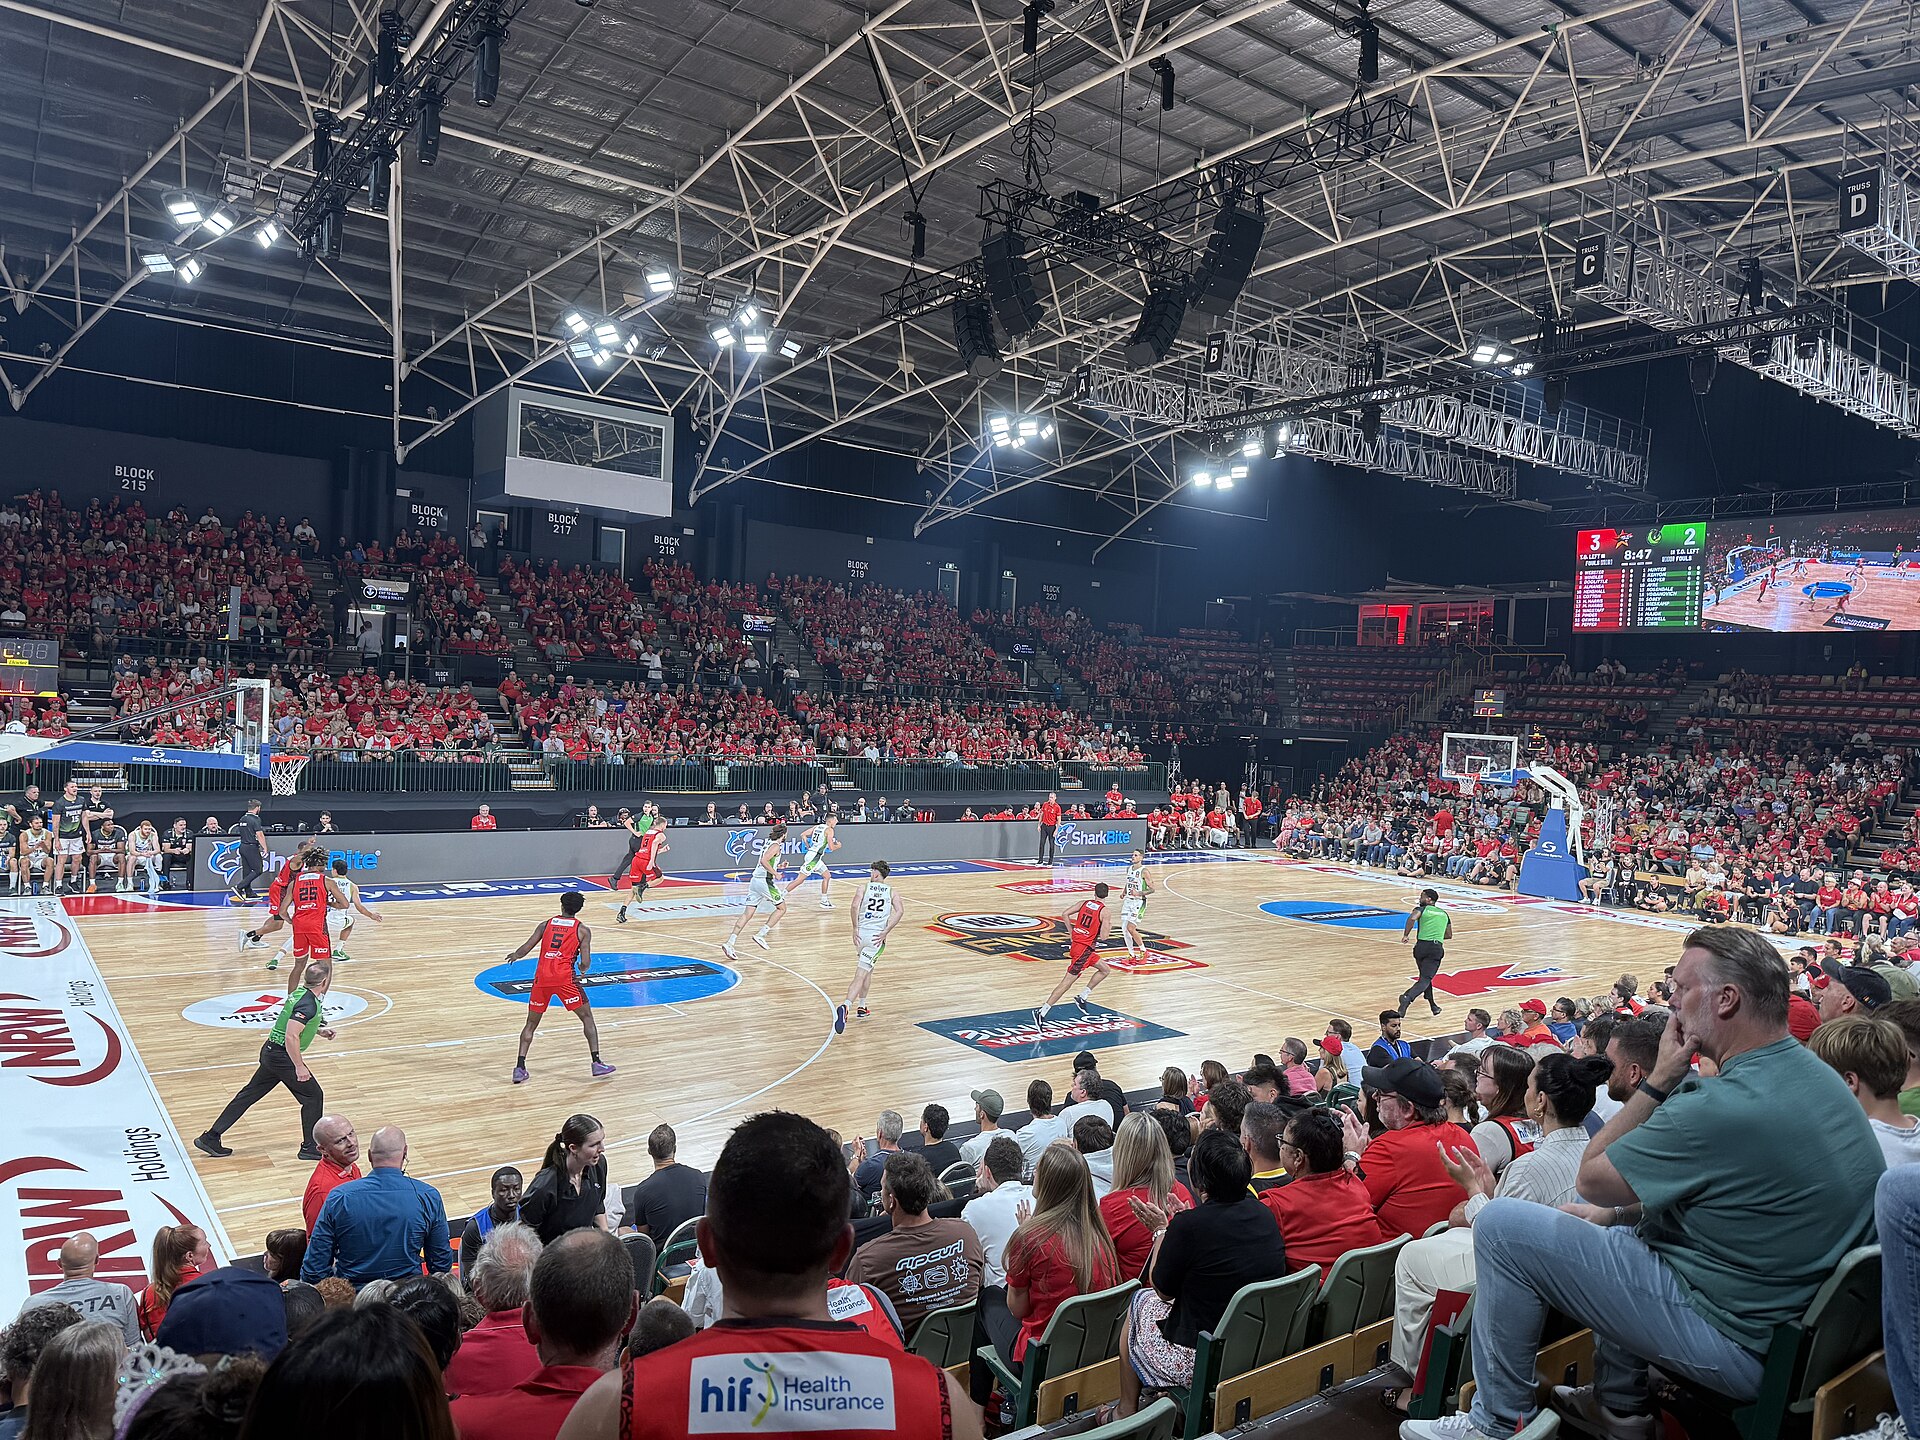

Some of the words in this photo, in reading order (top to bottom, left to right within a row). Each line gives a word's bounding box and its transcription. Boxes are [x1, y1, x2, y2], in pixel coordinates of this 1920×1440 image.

[1847, 180, 1871, 193] TRUSS
[1850, 193, 1867, 218] D
[1581, 244, 1599, 254] TRUSS
[1582, 254, 1596, 276] C
[1210, 347, 1219, 363] B
[115, 465, 154, 480] BLOCK
[121, 478, 147, 491] 215
[411, 504, 444, 517] BLOCK
[417, 515, 437, 527] 216
[548, 512, 578, 526] BLOCK
[553, 524, 572, 535] 217
[1684, 528, 1696, 546] 2
[654, 535, 680, 547] BLOCK
[1590, 534, 1601, 551] 3
[659, 545, 675, 555] 218
[1624, 549, 1652, 560] 8:47
[847, 560, 869, 570] BLOCK
[850, 569, 865, 578] 219
[71, 815, 80, 823] 15
[811, 833, 820, 844] 21
[1071, 829, 1131, 846] SharkBite
[298, 886, 320, 901] 25
[867, 898, 885, 912] 22
[1081, 913, 1093, 929] 10
[550, 933, 565, 949] 5
[65, 980, 96, 1007] Holdings
[0, 1007, 81, 1068] NRW
[986, 1020, 1135, 1047] warehouse
[123, 1126, 170, 1183] Holdings
[784, 1375, 851, 1394] Health
[700, 1376, 754, 1414] hif
[784, 1395, 885, 1412] Insurance
